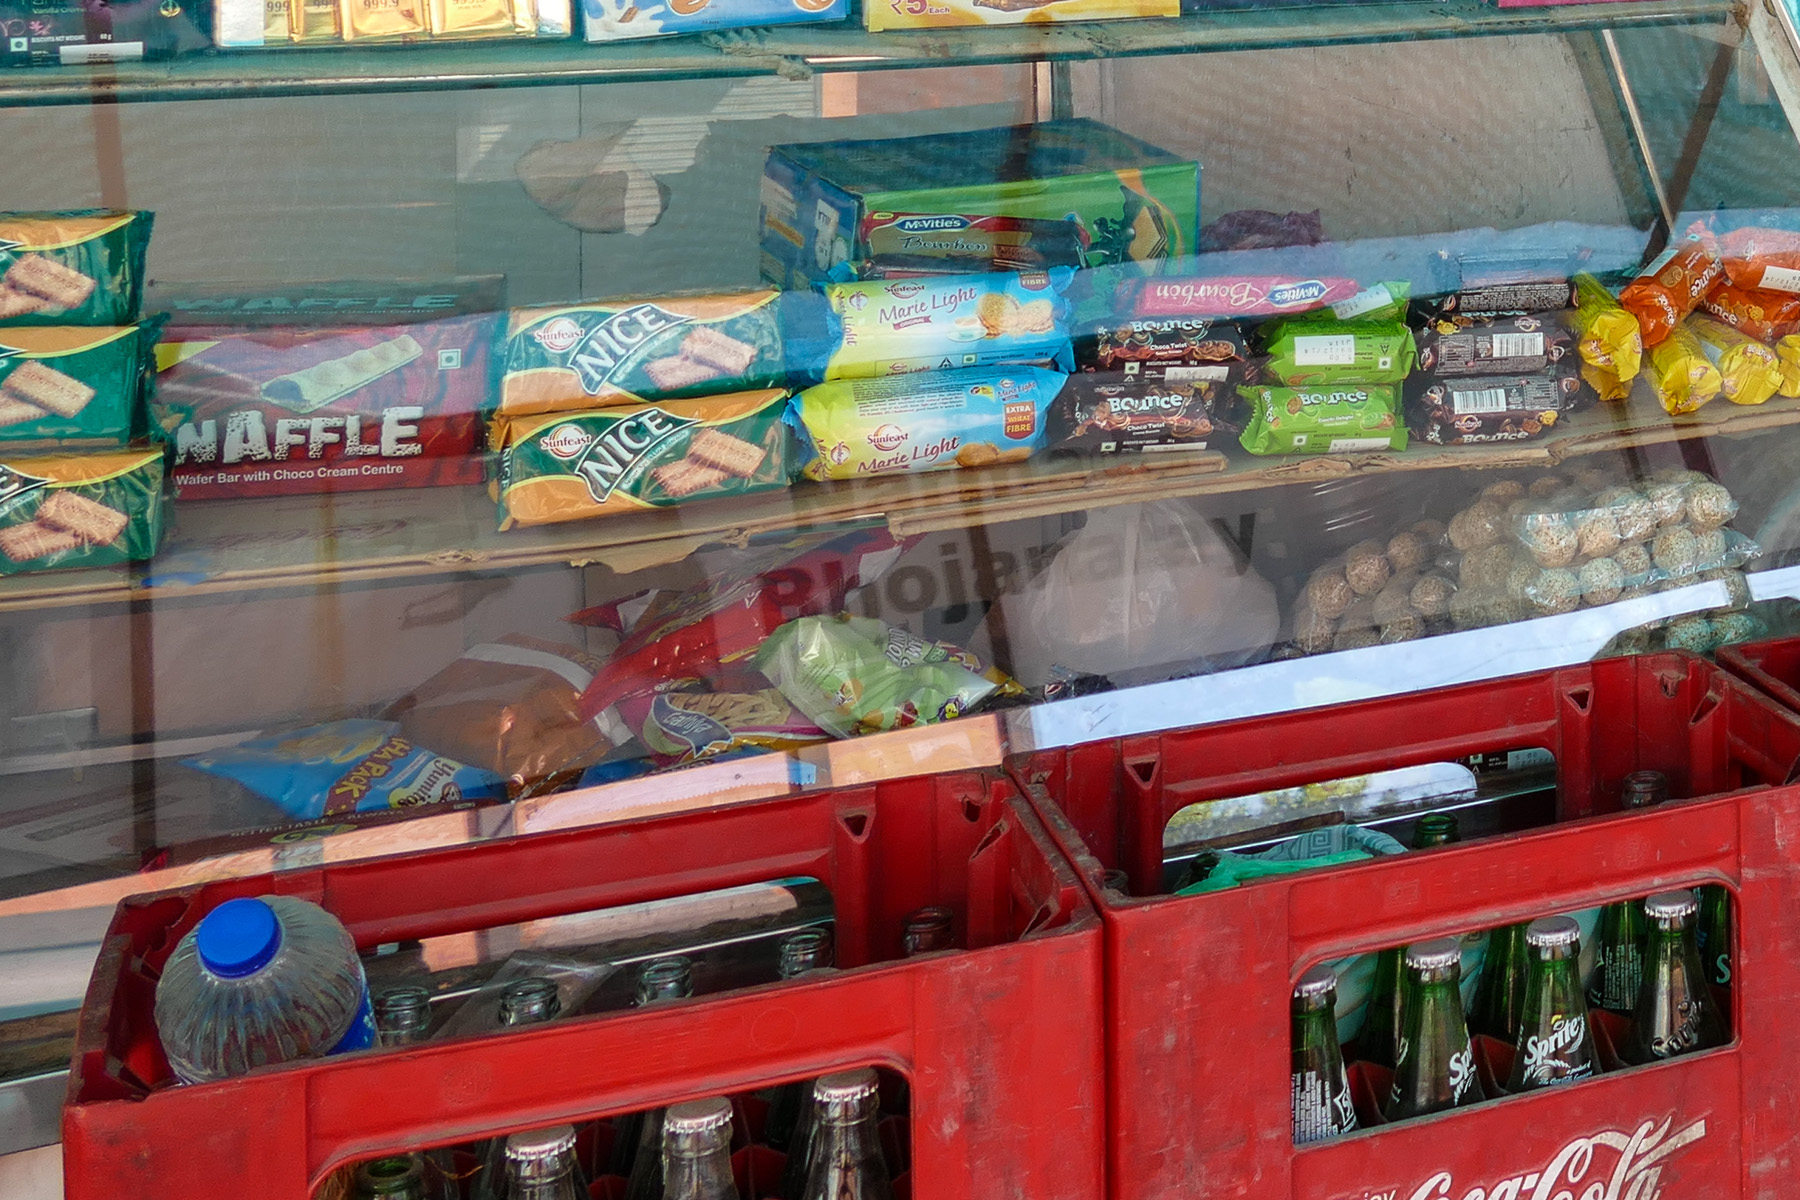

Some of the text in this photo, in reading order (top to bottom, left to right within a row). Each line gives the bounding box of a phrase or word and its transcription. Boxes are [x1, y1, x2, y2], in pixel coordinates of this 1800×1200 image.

[929, 6, 950, 14] Each
[903, 217, 962, 230] McVitie's
[899, 235, 989, 252] Bourbon
[883, 282, 926, 293] Sunfeast
[1020, 276, 1048, 286] FIBRE
[1156, 280, 1253, 306] Bourbon
[879, 287, 978, 324] Marie Light
[534, 326, 585, 342] Sunfeast
[574, 305, 667, 383] NICE
[1150, 341, 1188, 350] Choco Twist
[1005, 404, 1032, 414] EXTRA
[1006, 423, 1032, 434] FIBRE
[1126, 421, 1166, 432] Choco Twist
[540, 432, 592, 450] Sunfeast
[866, 431, 910, 445] Sunfeast
[583, 410, 675, 488] NICE
[857, 435, 961, 473] Marie Light
[176, 463, 405, 487] Wafer Bar with Choco Cream Centre
[335, 761, 391, 798] PACK
[1522, 1013, 1585, 1066] Sprite
